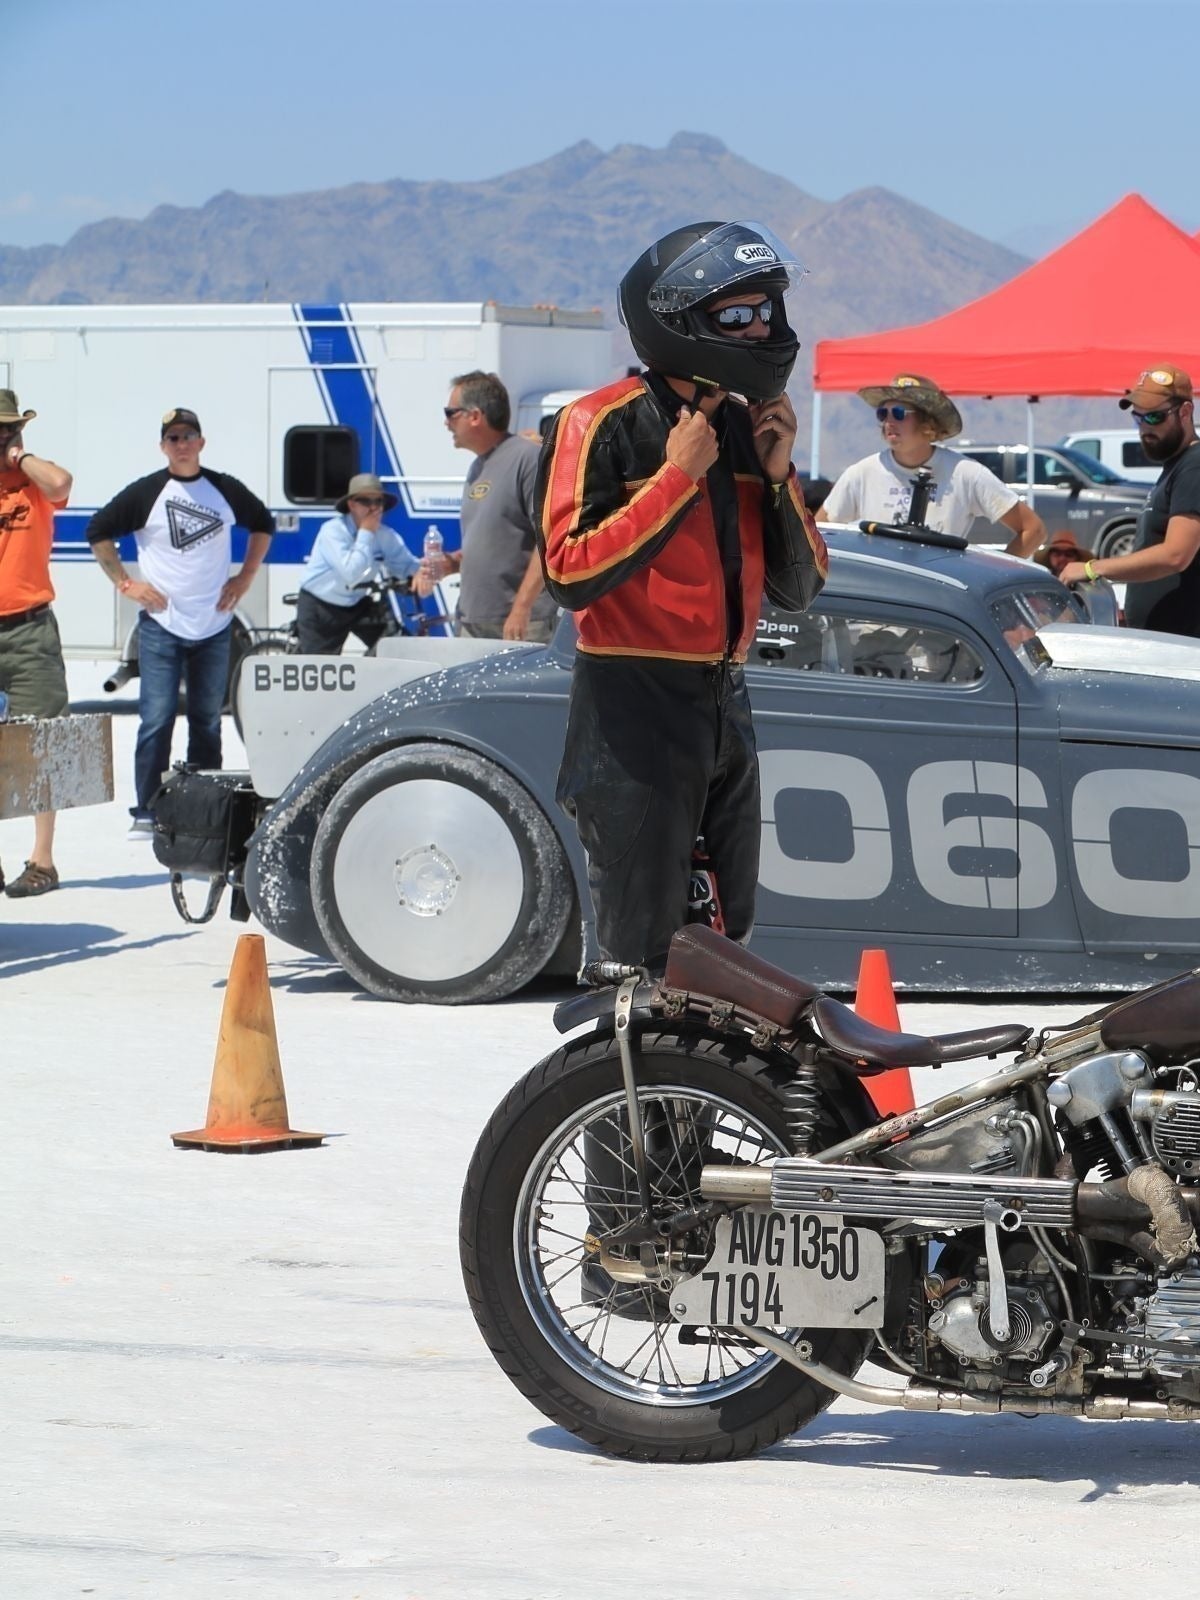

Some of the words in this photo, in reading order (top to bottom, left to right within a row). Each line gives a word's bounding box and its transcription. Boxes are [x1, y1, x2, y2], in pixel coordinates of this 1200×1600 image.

[756, 619, 799, 634] Open
[254, 664, 357, 692] B-BGCC
[702, 1271, 784, 1327] 7194
